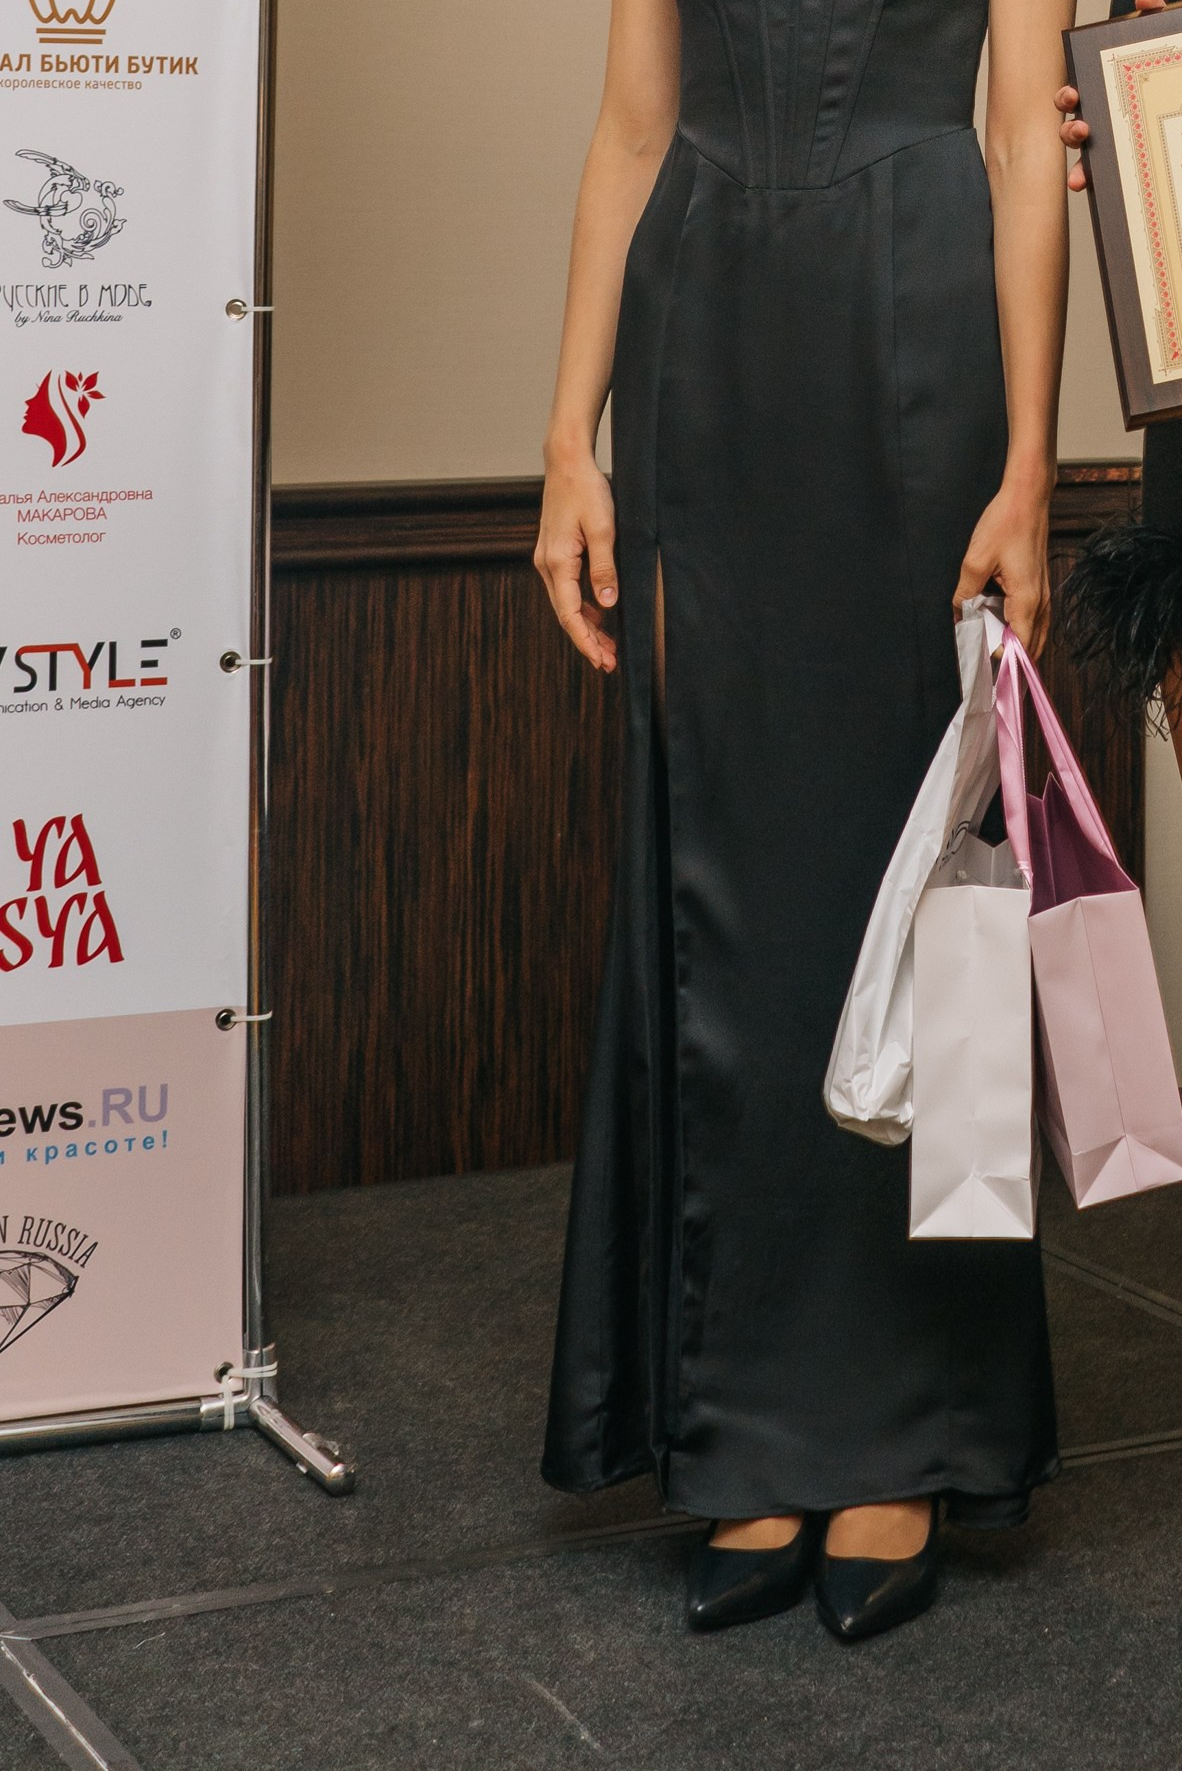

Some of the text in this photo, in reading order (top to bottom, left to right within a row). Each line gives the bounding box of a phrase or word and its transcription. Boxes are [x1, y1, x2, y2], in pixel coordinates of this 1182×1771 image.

[40, 54, 119, 74] БЬЮТИ
[127, 56, 199, 75] БУТИК
[84, 80, 142, 90] качество
[14, 309, 123, 328] by Nina Ruchkina
[37, 490, 153, 504] Александровна
[17, 507, 107, 523] МАКАРОВА
[17, 532, 106, 545] Косметолог
[54, 697, 64, 711] &
[70, 696, 110, 711] Media
[116, 695, 166, 709] Agency
[12, 813, 102, 892] YA
[0, 890, 125, 973] SYA
[26, 1130, 168, 1165] красоте!
[17, 1215, 99, 1269] RUSSIA
